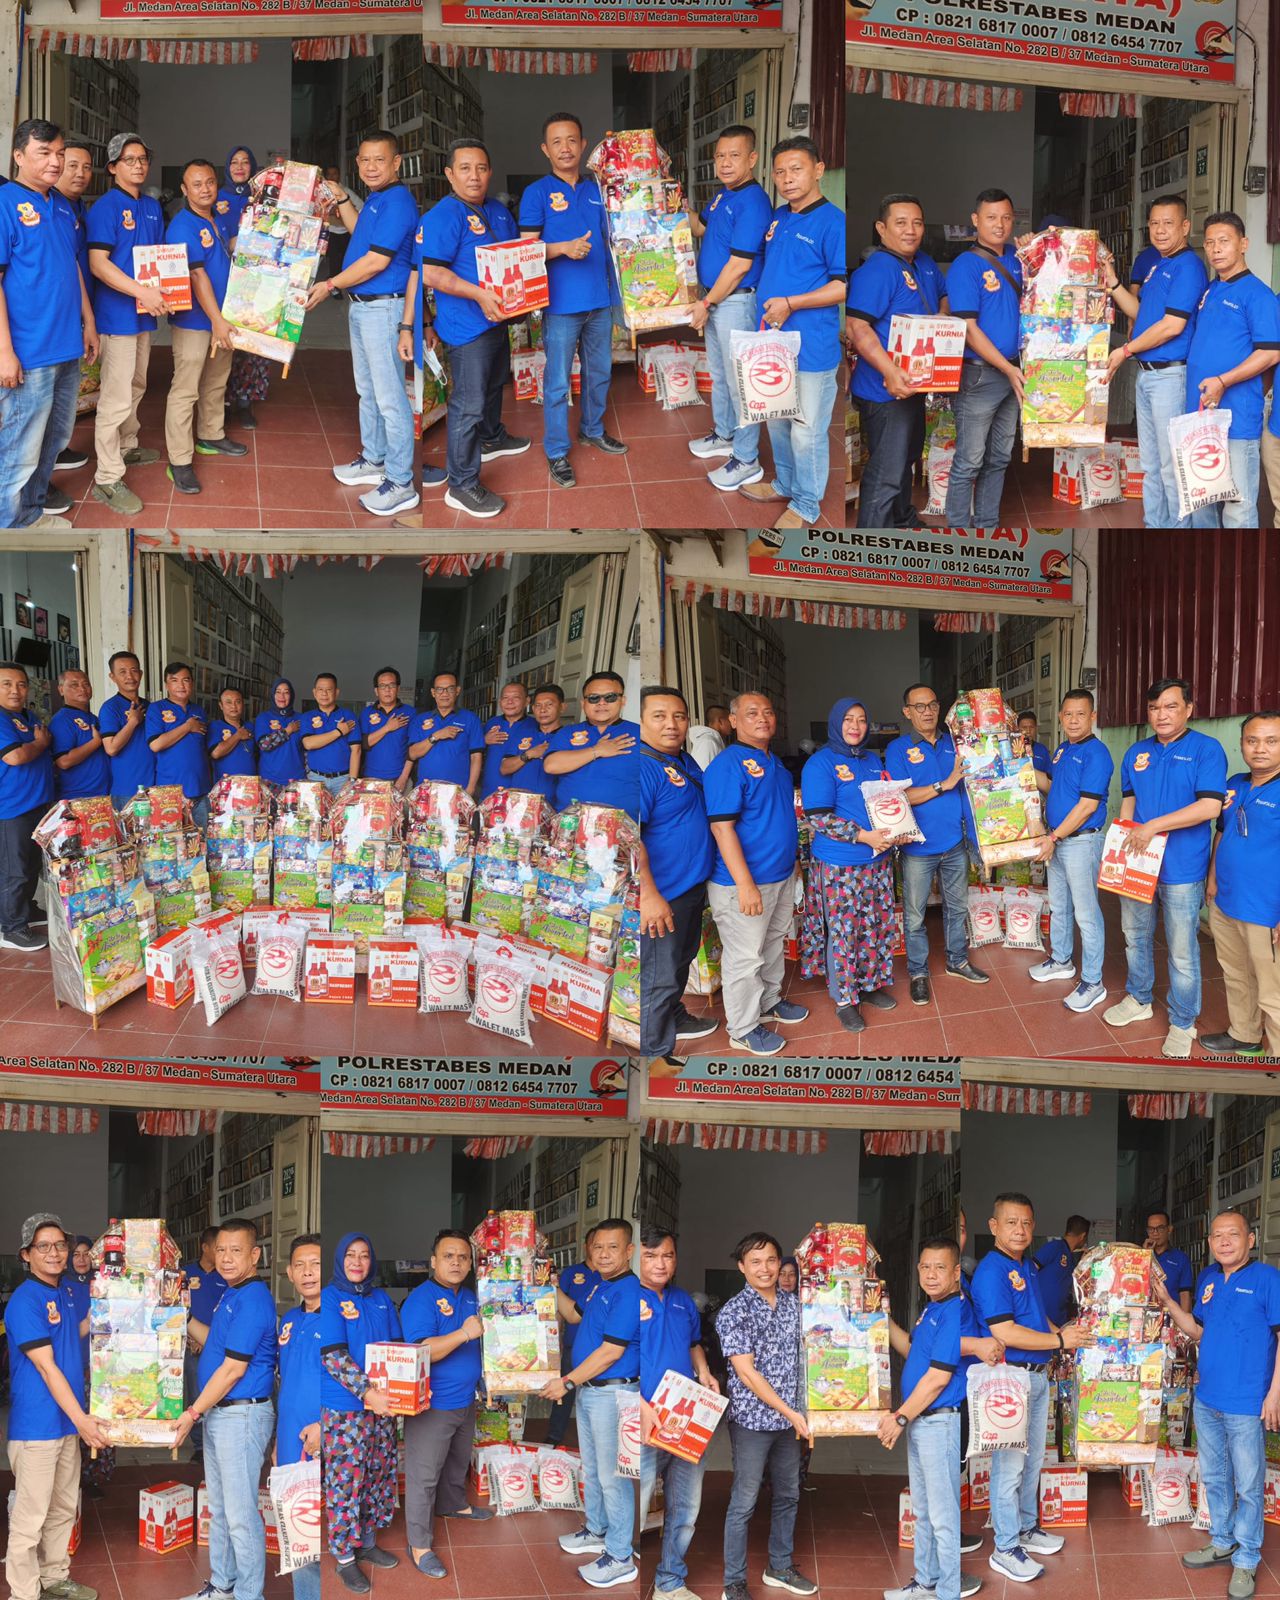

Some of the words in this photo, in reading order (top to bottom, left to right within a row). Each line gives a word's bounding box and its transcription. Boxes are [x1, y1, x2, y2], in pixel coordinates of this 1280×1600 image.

[124, 3, 135, 11] Jl.
[139, 2, 172, 11] Medan
[175, 2, 197, 10] Area
[201, 2, 239, 10] Selatan
[242, 1, 259, 10] No.
[262, 1, 279, 9] 282
[300, 0, 311, 8] 37
[466, 10, 477, 18] Jl.
[480, 10, 513, 19] Medan
[516, 10, 538, 19] Area
[542, 11, 577, 20] Selatan
[580, 12, 596, 20] No.
[600, 12, 616, 20] 282
[634, 12, 644, 20] 37
[648, 12, 678, 21] Medan
[687, 13, 731, 22] Sumatera
[734, 13, 758, 22] Utara
[1096, 12, 1175, 34] MEDAN
[896, 8, 918, 22] CP
[935, 13, 973, 29] 0821
[979, 18, 1016, 34] 6817
[1022, 24, 1057, 39] 0007
[1071, 30, 1105, 44] 0812
[1111, 34, 1145, 49] 6454
[1150, 39, 1182, 53] 7707
[862, 26, 875, 36] Jl.
[881, 27, 921, 42] Medan
[926, 33, 953, 45] Area
[958, 36, 1001, 51] Selatan
[1005, 42, 1024, 54] No.
[1028, 44, 1047, 55] 282
[1051, 47, 1058, 56] B
[1069, 49, 1080, 59] 37
[1085, 50, 1120, 63] Medan
[1130, 56, 1178, 70] Sumatera
[1182, 62, 1208, 73] Utara
[520, 252, 544, 262] KURNIA
[749, 400, 766, 411] Cap
[750, 411, 779, 421] WALET
[781, 408, 798, 416] MAS
[1191, 488, 1206, 497] Cap
[1192, 494, 1218, 510] WALET
[1220, 489, 1236, 500] MAS
[808, 529, 954, 555] POLRESTABES
[960, 546, 1023, 562] MEDAN
[801, 547, 819, 557] CP
[832, 550, 862, 562] 0821
[867, 553, 897, 565] 6817
[902, 557, 930, 569] 0007
[942, 560, 969, 572] 0812
[973, 564, 1000, 575] 6454
[1004, 566, 1030, 578] 7707
[775, 562, 786, 571] Jl.
[790, 563, 823, 574] Medan
[826, 567, 848, 576] Area
[852, 569, 886, 580] Selatan
[890, 572, 904, 581] No.
[908, 574, 922, 583] 282
[926, 576, 932, 584] B
[940, 577, 950, 585] 37
[953, 578, 981, 588] Medan
[989, 582, 1028, 592] Sumatera
[1030, 585, 1050, 593] Utara
[1126, 875, 1153, 886] RASPBERRY
[561, 961, 592, 976] KURNIA
[281, 989, 294, 997] MAS
[570, 978, 601, 995] KURNIA
[475, 1015, 500, 1032] WALET
[502, 1026, 520, 1038] MAS
[0, 1055, 26, 1066] Area
[30, 1057, 75, 1070] Selatan
[79, 1061, 99, 1072] No.
[103, 1063, 122, 1073] 282
[127, 1064, 135, 1074] B
[146, 1065, 159, 1076] 37
[163, 1067, 200, 1078] Medan
[211, 1070, 264, 1082] Sumatera
[267, 1073, 296, 1084] Utara
[338, 1056, 491, 1074] POLRESTABES
[499, 1062, 571, 1075] MEDAN
[707, 1063, 727, 1076] CP
[742, 1064, 777, 1077] 0821
[784, 1066, 820, 1079] 6817
[826, 1067, 862, 1080] 0007
[875, 1069, 912, 1082] 0812
[917, 1070, 954, 1083] 6454
[330, 1074, 348, 1086] CP
[361, 1076, 393, 1088] 0821
[398, 1078, 429, 1089] 6817
[434, 1080, 465, 1091] 0007
[477, 1080, 508, 1092] 0812
[512, 1082, 543, 1093] 6454
[548, 1083, 577, 1094] 7707
[676, 1082, 689, 1092] Jl.
[693, 1083, 730, 1094] Medan
[734, 1085, 759, 1095] Area
[764, 1086, 805, 1096] Selatan
[809, 1087, 827, 1097] No.
[832, 1088, 851, 1097] 282
[855, 1089, 862, 1098] B
[873, 1089, 886, 1099] 37
[890, 1090, 926, 1100] Medan
[354, 1095, 380, 1104] Area
[382, 1095, 416, 1105] Selatan
[420, 1097, 436, 1106] No.
[440, 1098, 456, 1106] 282
[460, 1098, 466, 1106] B
[476, 1099, 485, 1107] 37
[489, 1099, 520, 1108] Medan
[530, 1101, 574, 1110] Sumatera
[577, 1102, 602, 1110] Utara
[386, 1355, 414, 1364] KURNIA
[700, 1398, 723, 1413] KURNIA
[686, 1430, 708, 1443] RASPBERRY
[981, 1431, 998, 1441] Cap
[981, 1442, 1008, 1451] WALET
[618, 1453, 631, 1465] Cap
[1157, 1517, 1178, 1525] WALET
[292, 1543, 309, 1554] Cap
